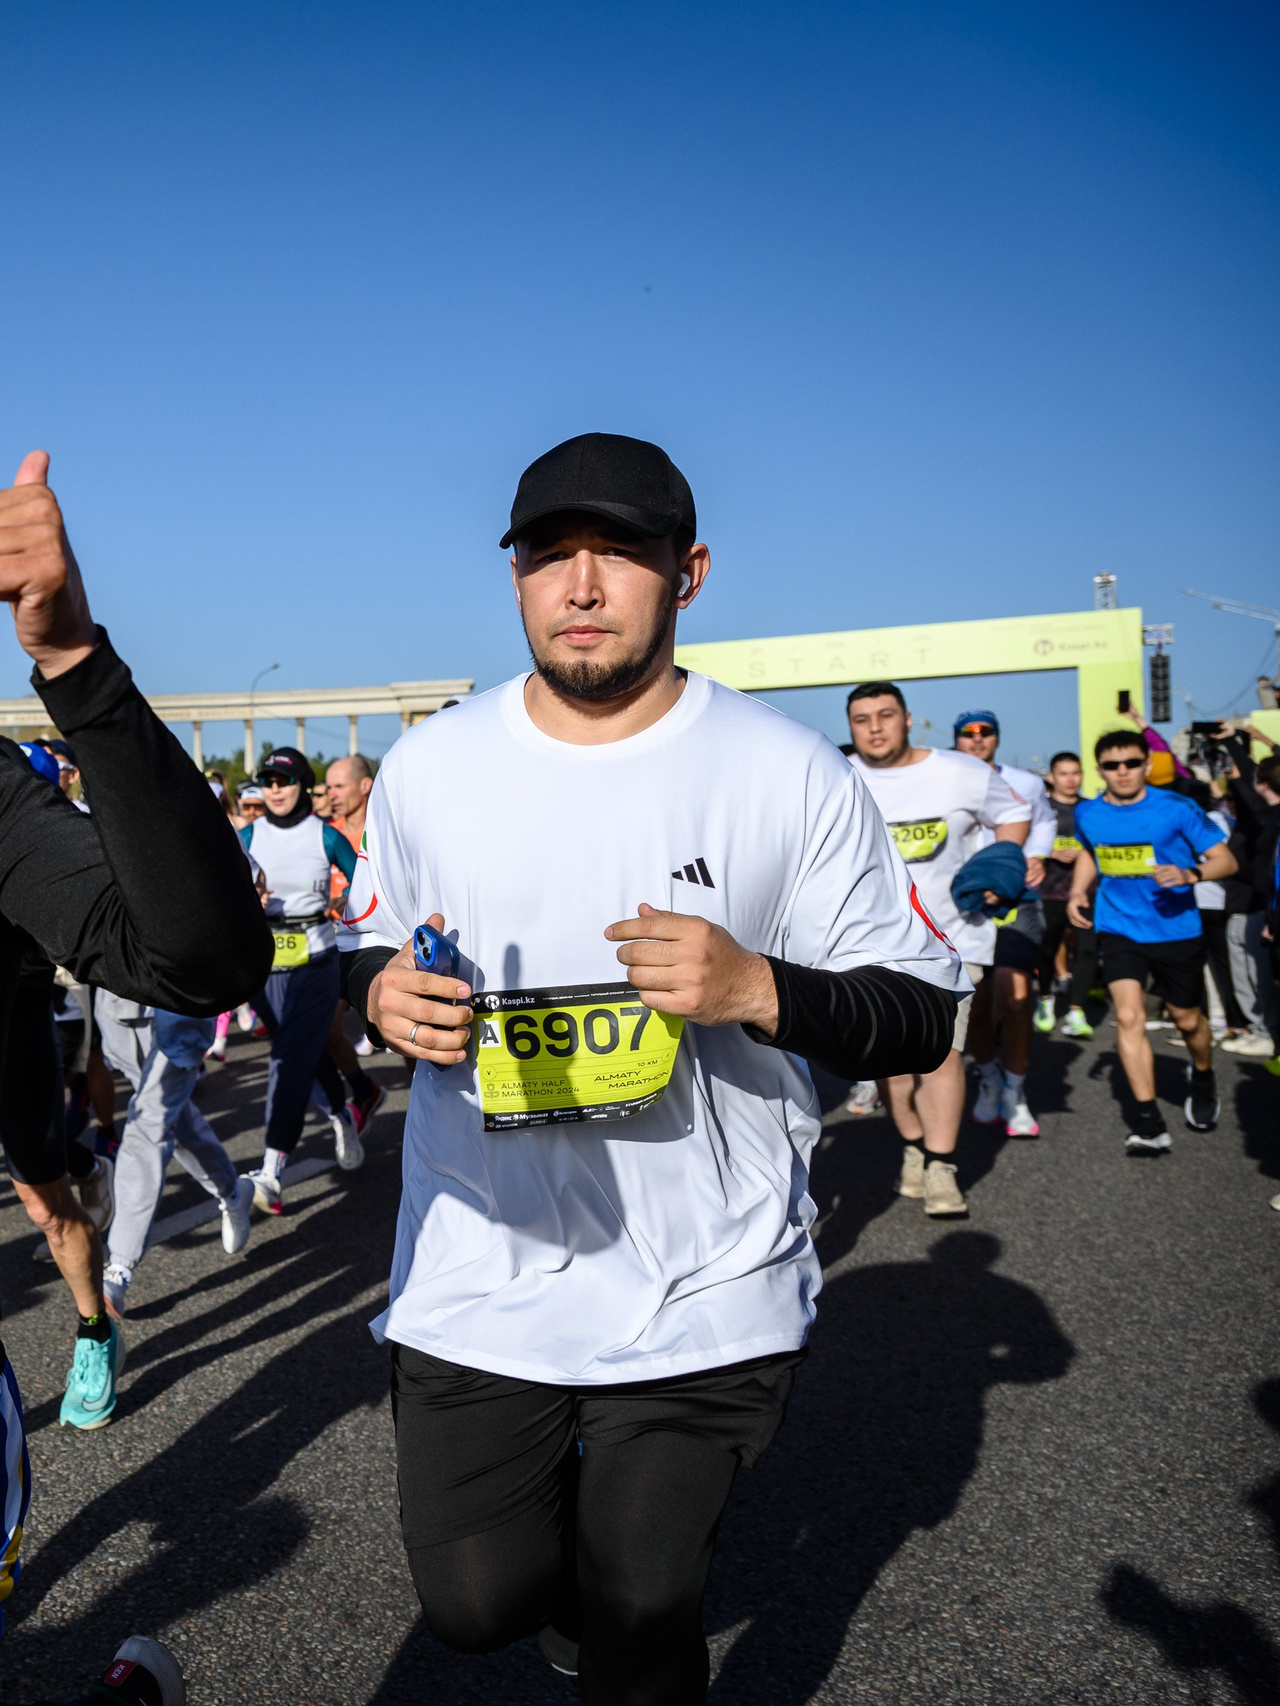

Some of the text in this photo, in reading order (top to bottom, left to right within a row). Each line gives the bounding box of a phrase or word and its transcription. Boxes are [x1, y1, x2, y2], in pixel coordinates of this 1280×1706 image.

[748, 648, 932, 678] START
[501, 996, 536, 1006] Kaspi.kz
[482, 1023, 499, 1045] A
[504, 1005, 653, 1060] 6907
[594, 1070, 641, 1081] ALMATY
[608, 1070, 669, 1089] MARATHON
[501, 1081, 539, 1089] ALMATY
[502, 1089, 554, 1097] MARATHON
